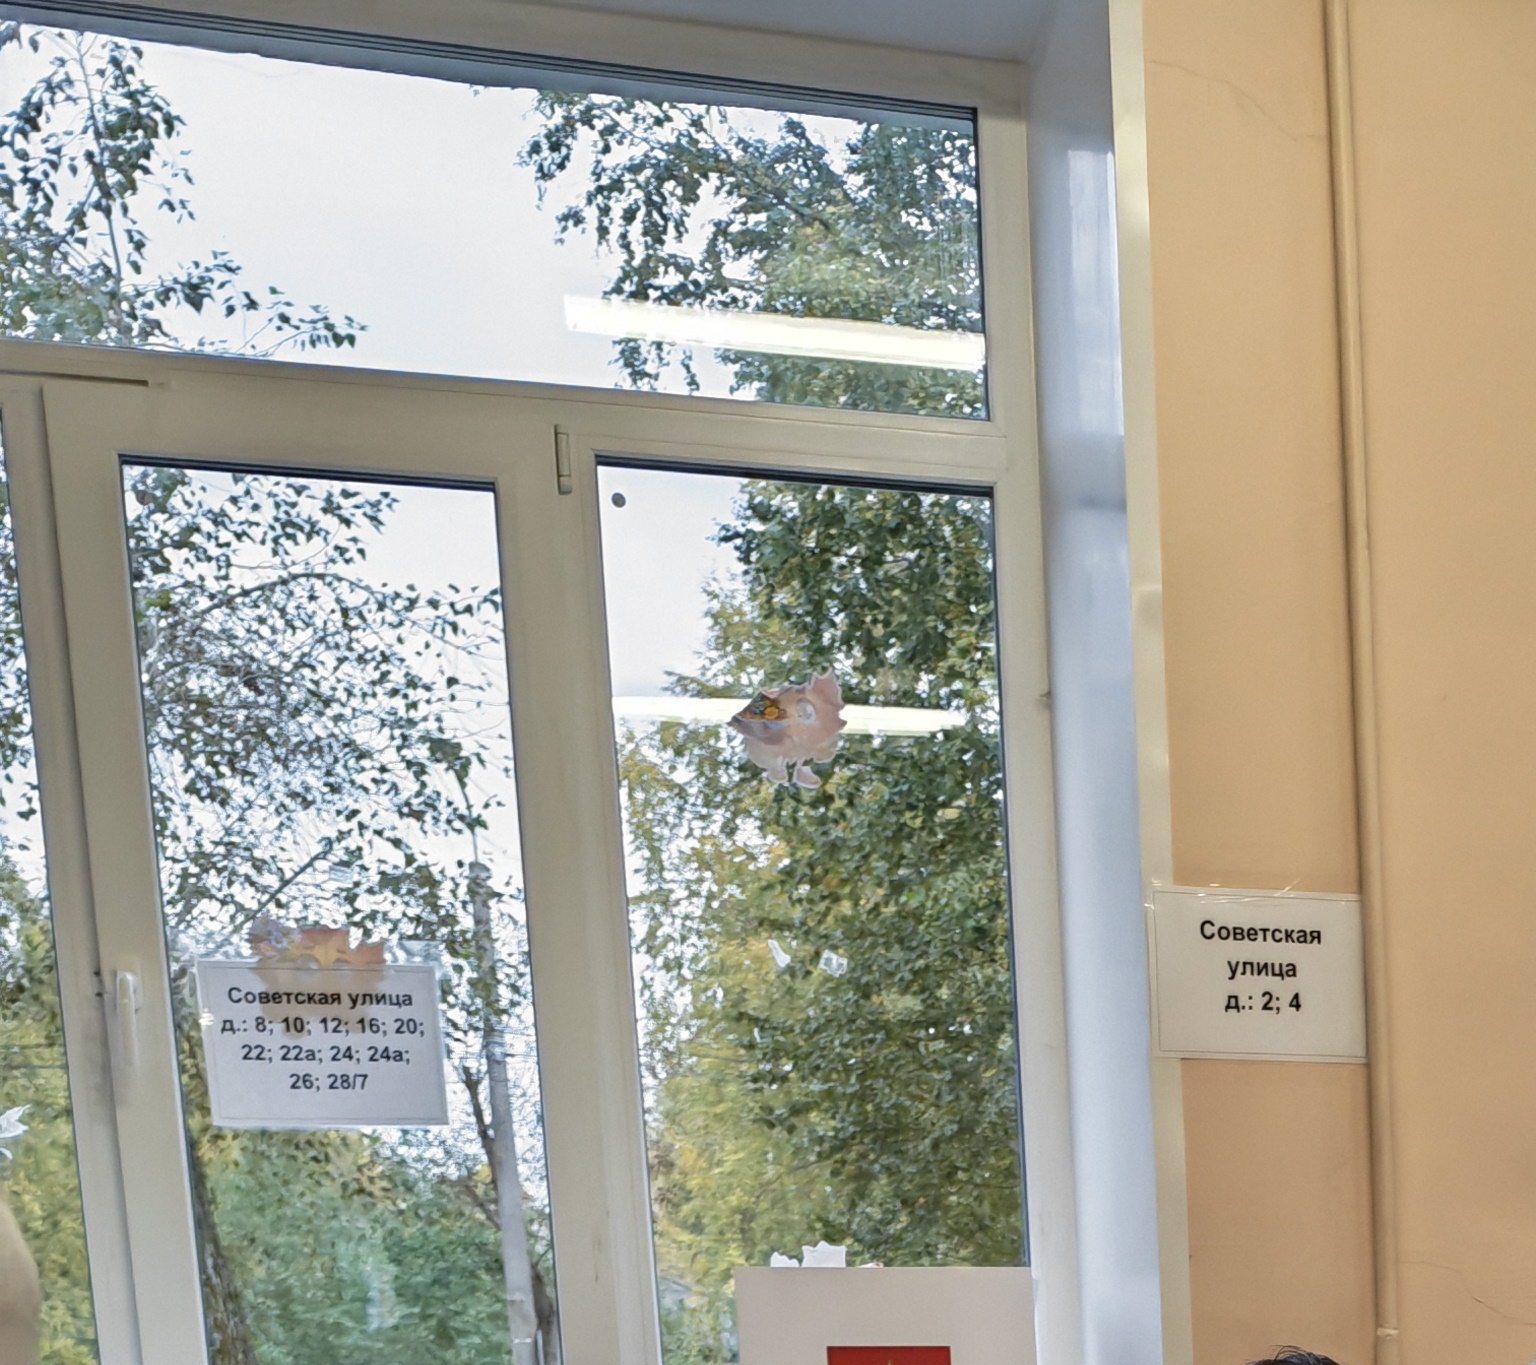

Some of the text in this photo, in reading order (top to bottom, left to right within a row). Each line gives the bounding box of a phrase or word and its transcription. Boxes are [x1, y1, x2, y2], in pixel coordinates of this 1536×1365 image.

[1200, 920, 1322, 944] Советская
[1227, 960, 1297, 981] улица
[227, 986, 413, 1010] Советская улица
[1225, 991, 1302, 1015] д.: 2; 4
[220, 1016, 425, 1037] д.: 8; 10; 12; 16; 20;
[241, 1044, 411, 1064] 22; 22а; 24; 24а;
[289, 1073, 369, 1092] 26; 28/7
